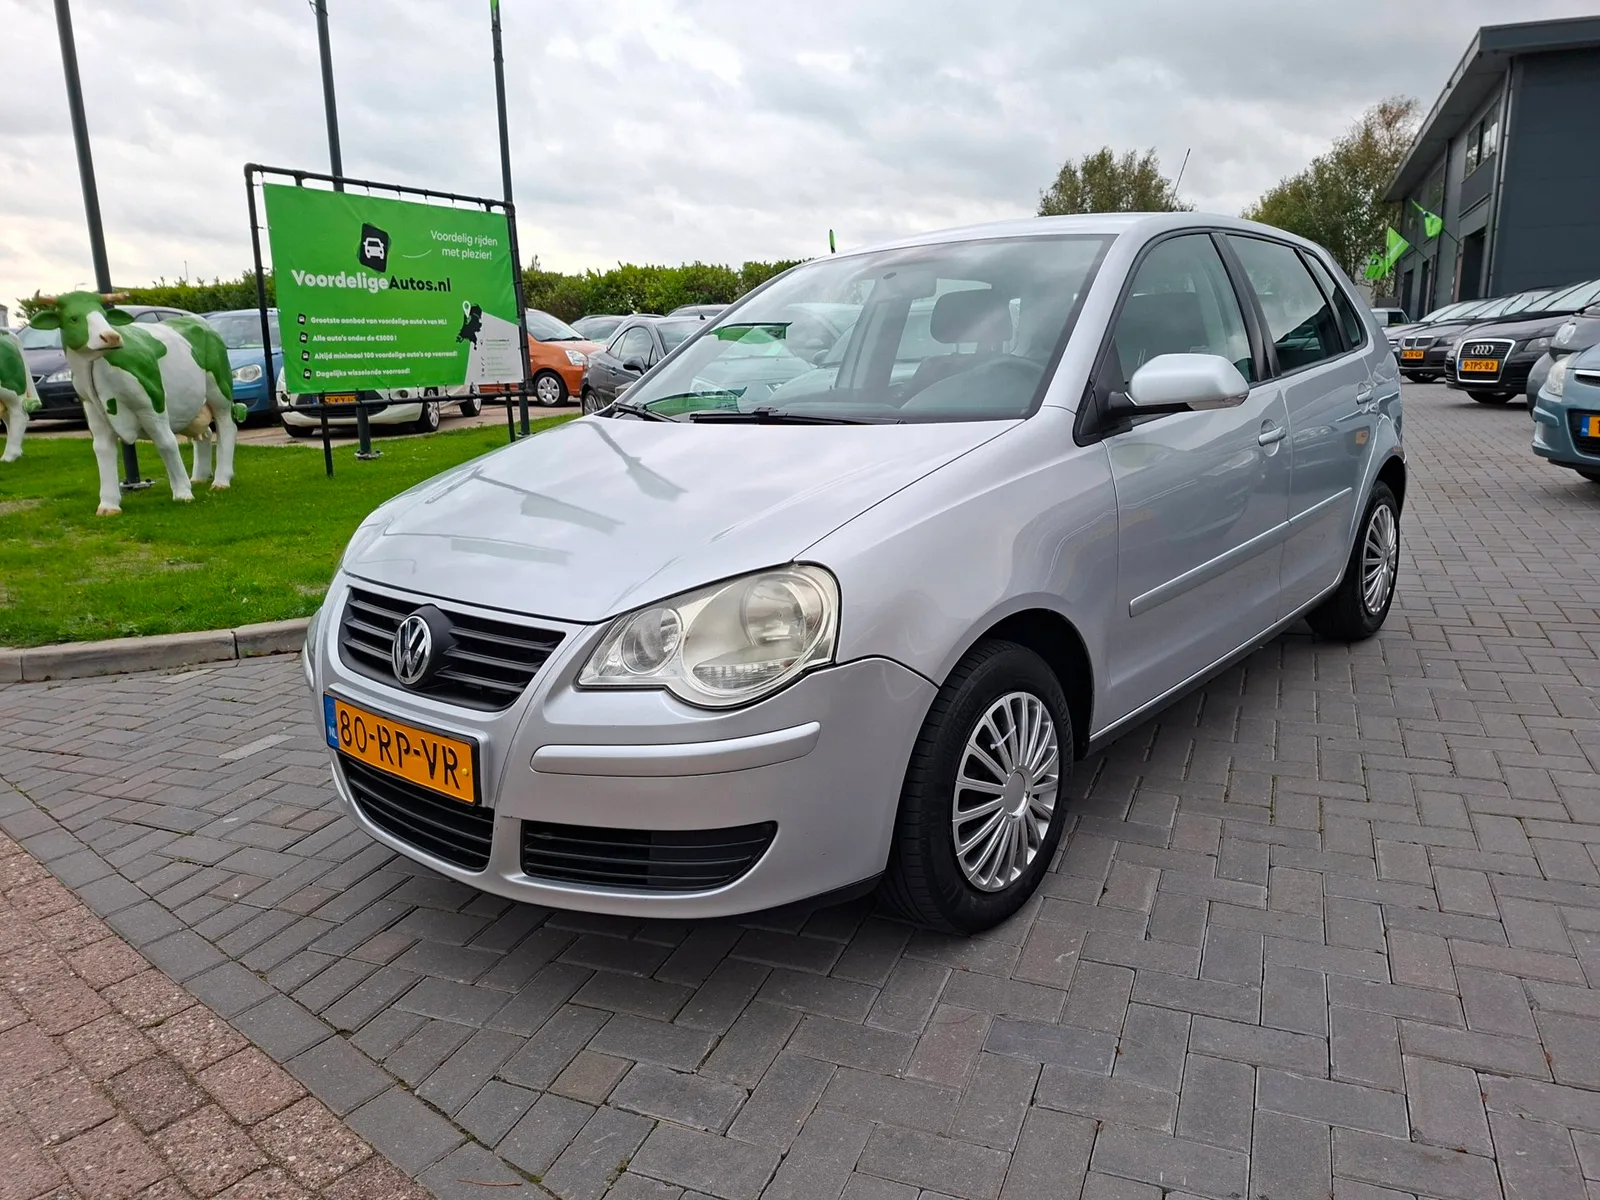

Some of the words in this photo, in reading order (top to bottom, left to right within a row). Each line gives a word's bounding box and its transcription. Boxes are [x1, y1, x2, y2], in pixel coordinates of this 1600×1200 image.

[430, 229, 474, 246] Voordelig
[474, 235, 498, 248] rijden
[441, 247, 460, 257] met
[461, 248, 493, 260] plezier!
[291, 269, 452, 294] VoordeligeAutos.nl
[378, 317, 409, 326] voordelige
[314, 352, 333, 360] Altijd
[333, 351, 363, 359] minimaal
[375, 351, 406, 359] voordelige
[1463, 361, 1496, 371] 9-TPS-82
[315, 369, 347, 378] Dagelijks
[347, 368, 382, 376] wisselende
[328, 725, 338, 740] NL
[339, 709, 461, 790] 80-RP-VR
